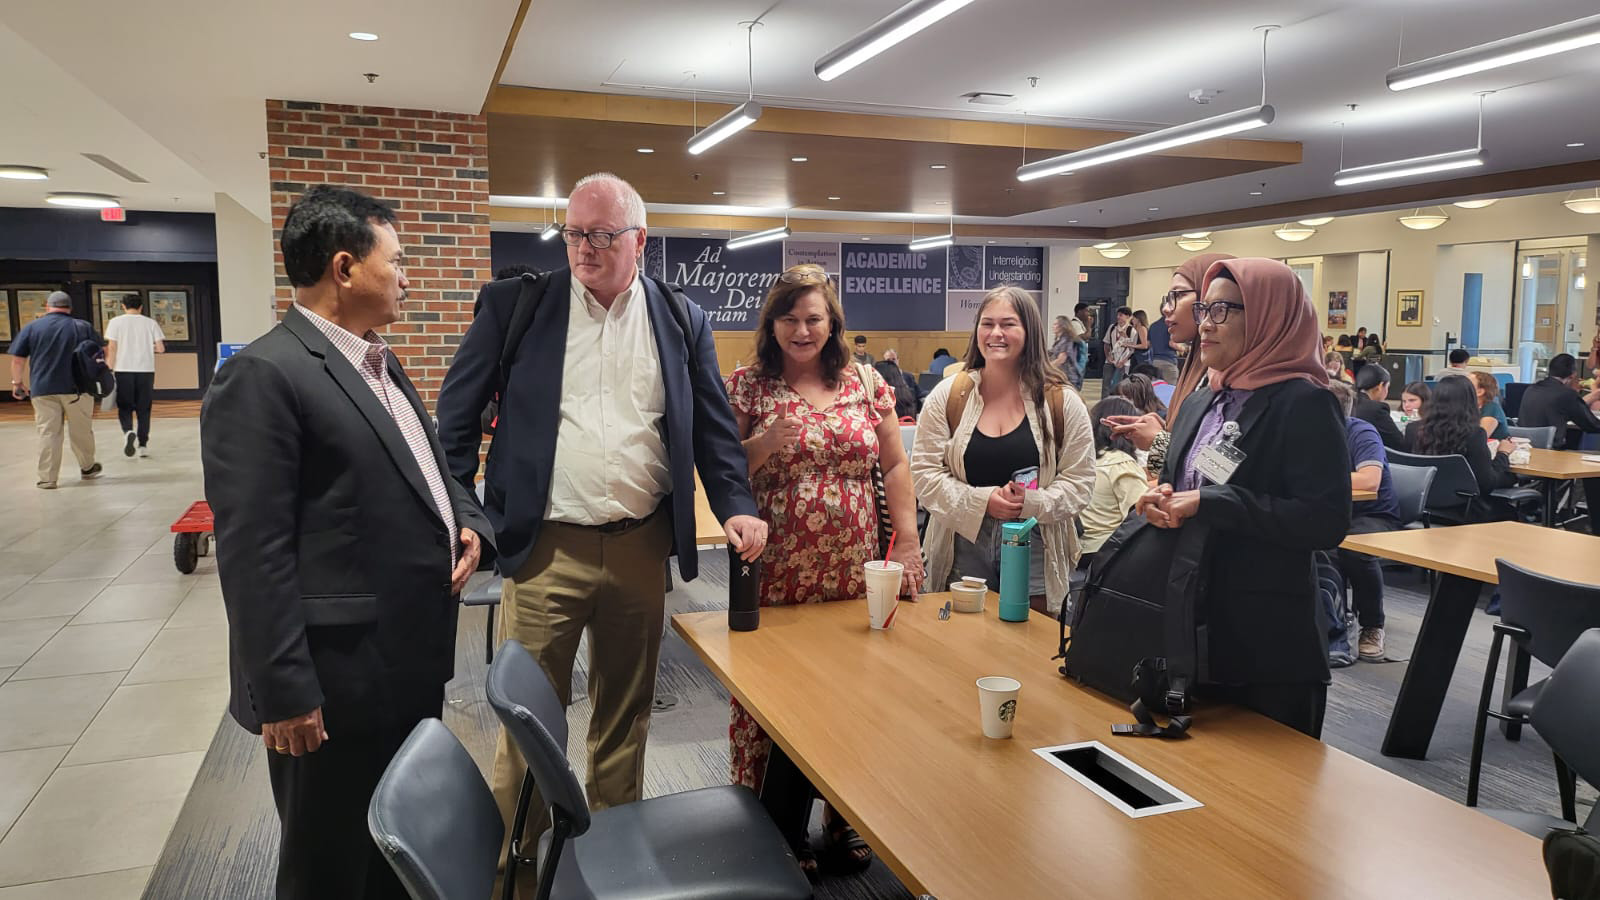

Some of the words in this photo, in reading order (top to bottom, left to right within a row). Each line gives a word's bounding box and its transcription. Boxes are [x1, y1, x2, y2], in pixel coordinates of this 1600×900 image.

[694, 246, 723, 263] Ad
[845, 252, 927, 270] ACADEMIC
[992, 256, 1039, 268] Interreligious
[674, 262, 780, 294] Majorem
[988, 270, 1041, 282] Understanding
[845, 277, 942, 294] EXCELLENCE
[724, 288, 762, 309] Dei
[703, 305, 748, 322] riam
